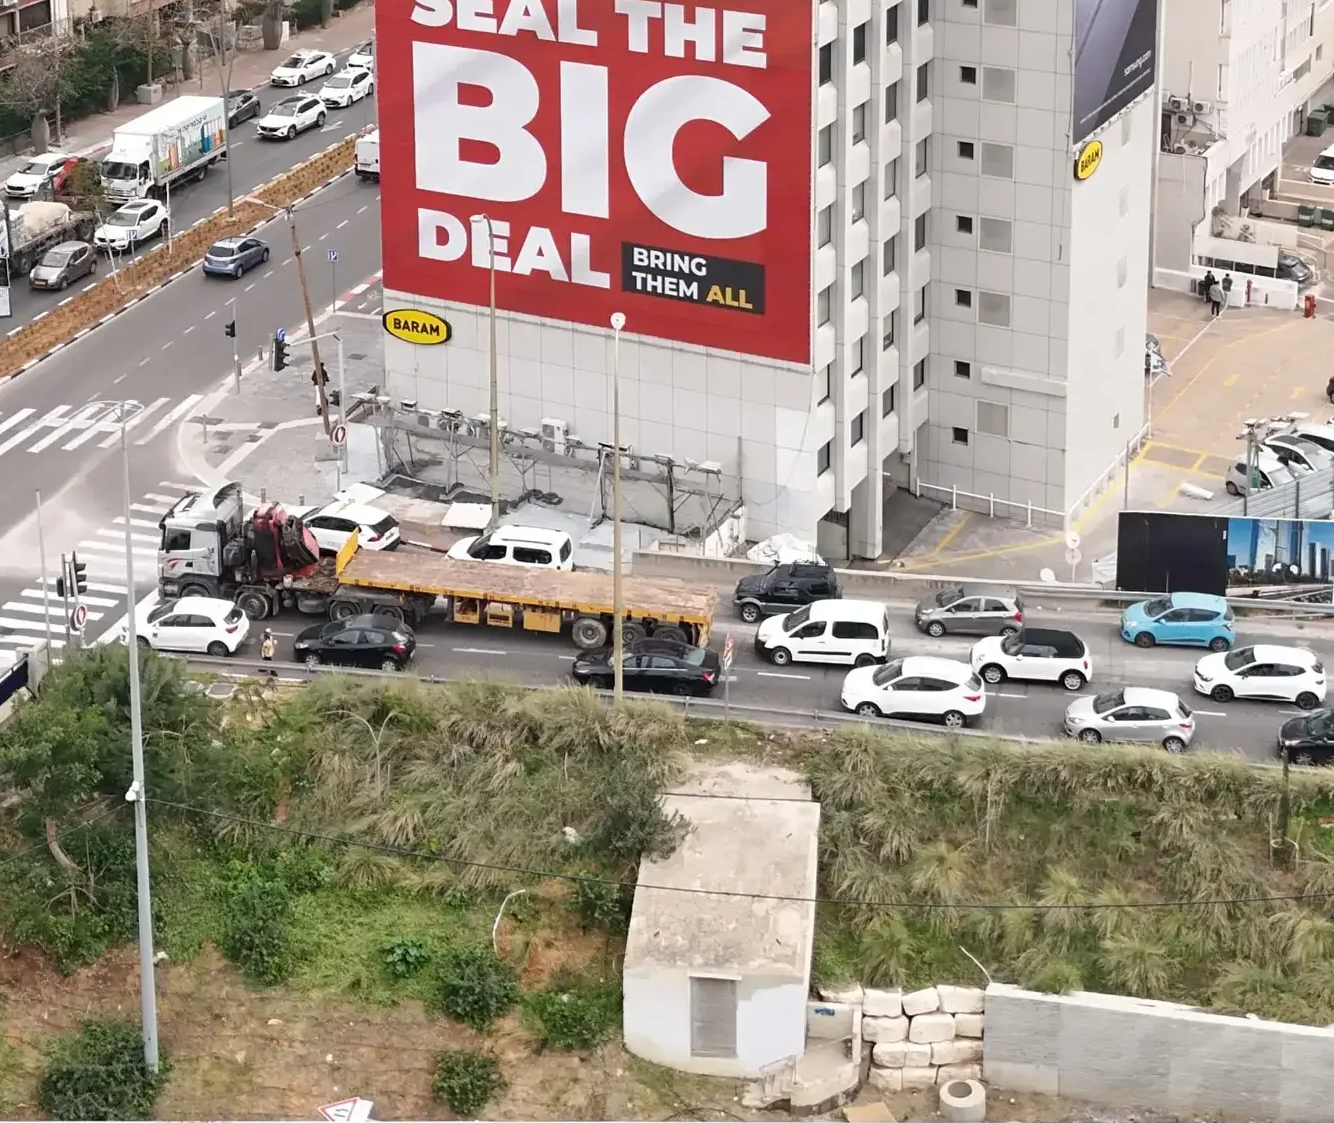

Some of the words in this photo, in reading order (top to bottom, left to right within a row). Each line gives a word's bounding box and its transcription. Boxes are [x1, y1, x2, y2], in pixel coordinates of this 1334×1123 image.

[412, 41, 771, 240] BIG
[1081, 147, 1099, 173] BARAM
[417, 208, 611, 289] DEAL
[632, 247, 707, 276] BRING
[632, 271, 699, 300] THEM
[706, 285, 753, 309] ALL
[393, 317, 440, 337] BARAM
